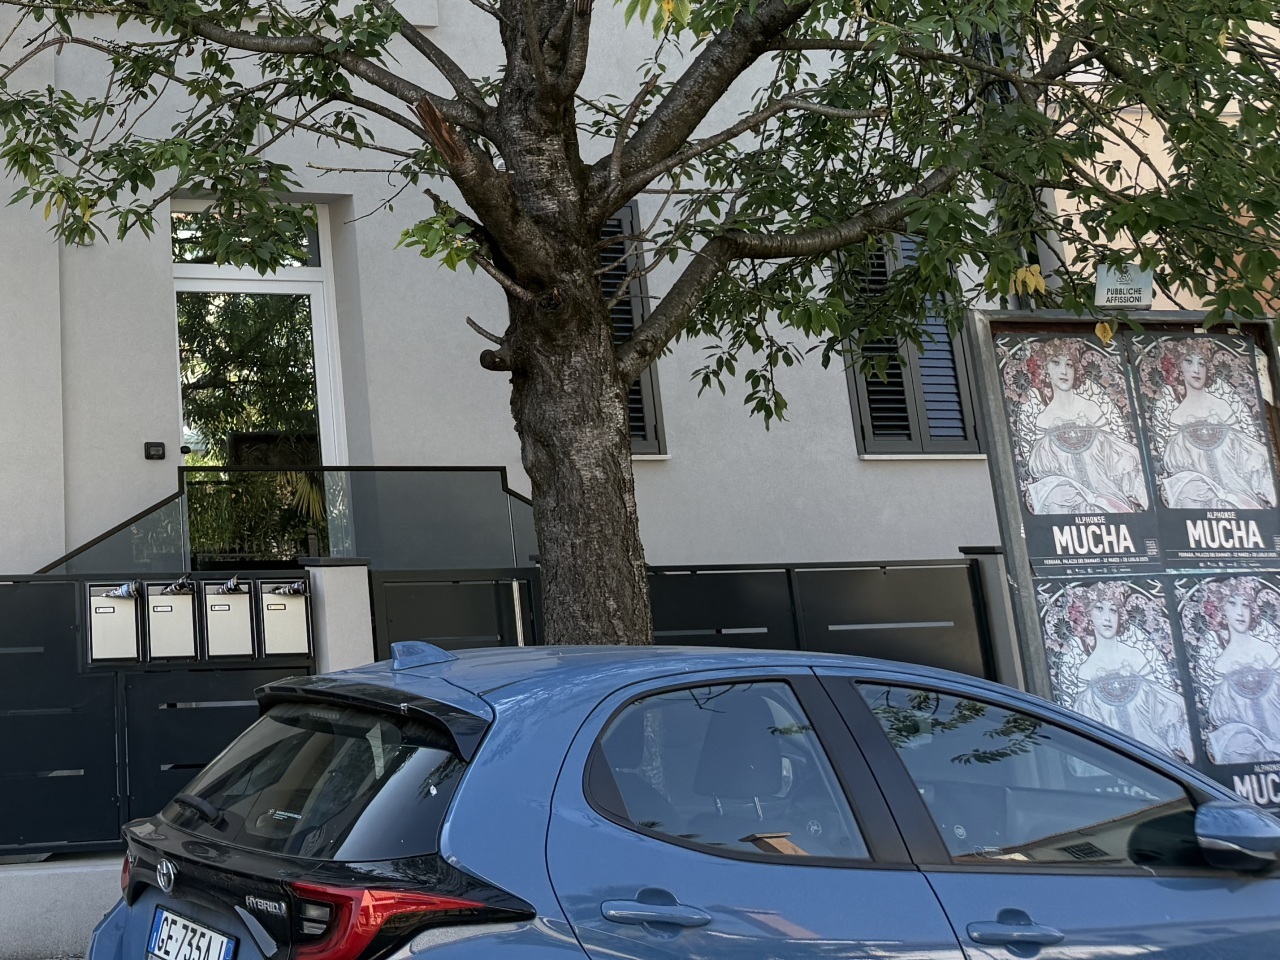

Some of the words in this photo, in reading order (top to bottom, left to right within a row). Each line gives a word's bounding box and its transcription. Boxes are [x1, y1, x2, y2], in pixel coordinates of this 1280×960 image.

[1106, 287, 1142, 296] PUBBLICHE
[1105, 296, 1142, 304] AFFISSIONI
[1075, 515, 1106, 524] ALPHONSE
[1206, 511, 1237, 519] ALPHONSE
[1185, 519, 1266, 549] MUCHA
[1052, 524, 1136, 555] MUCHA
[245, 895, 279, 912] HYBRID
